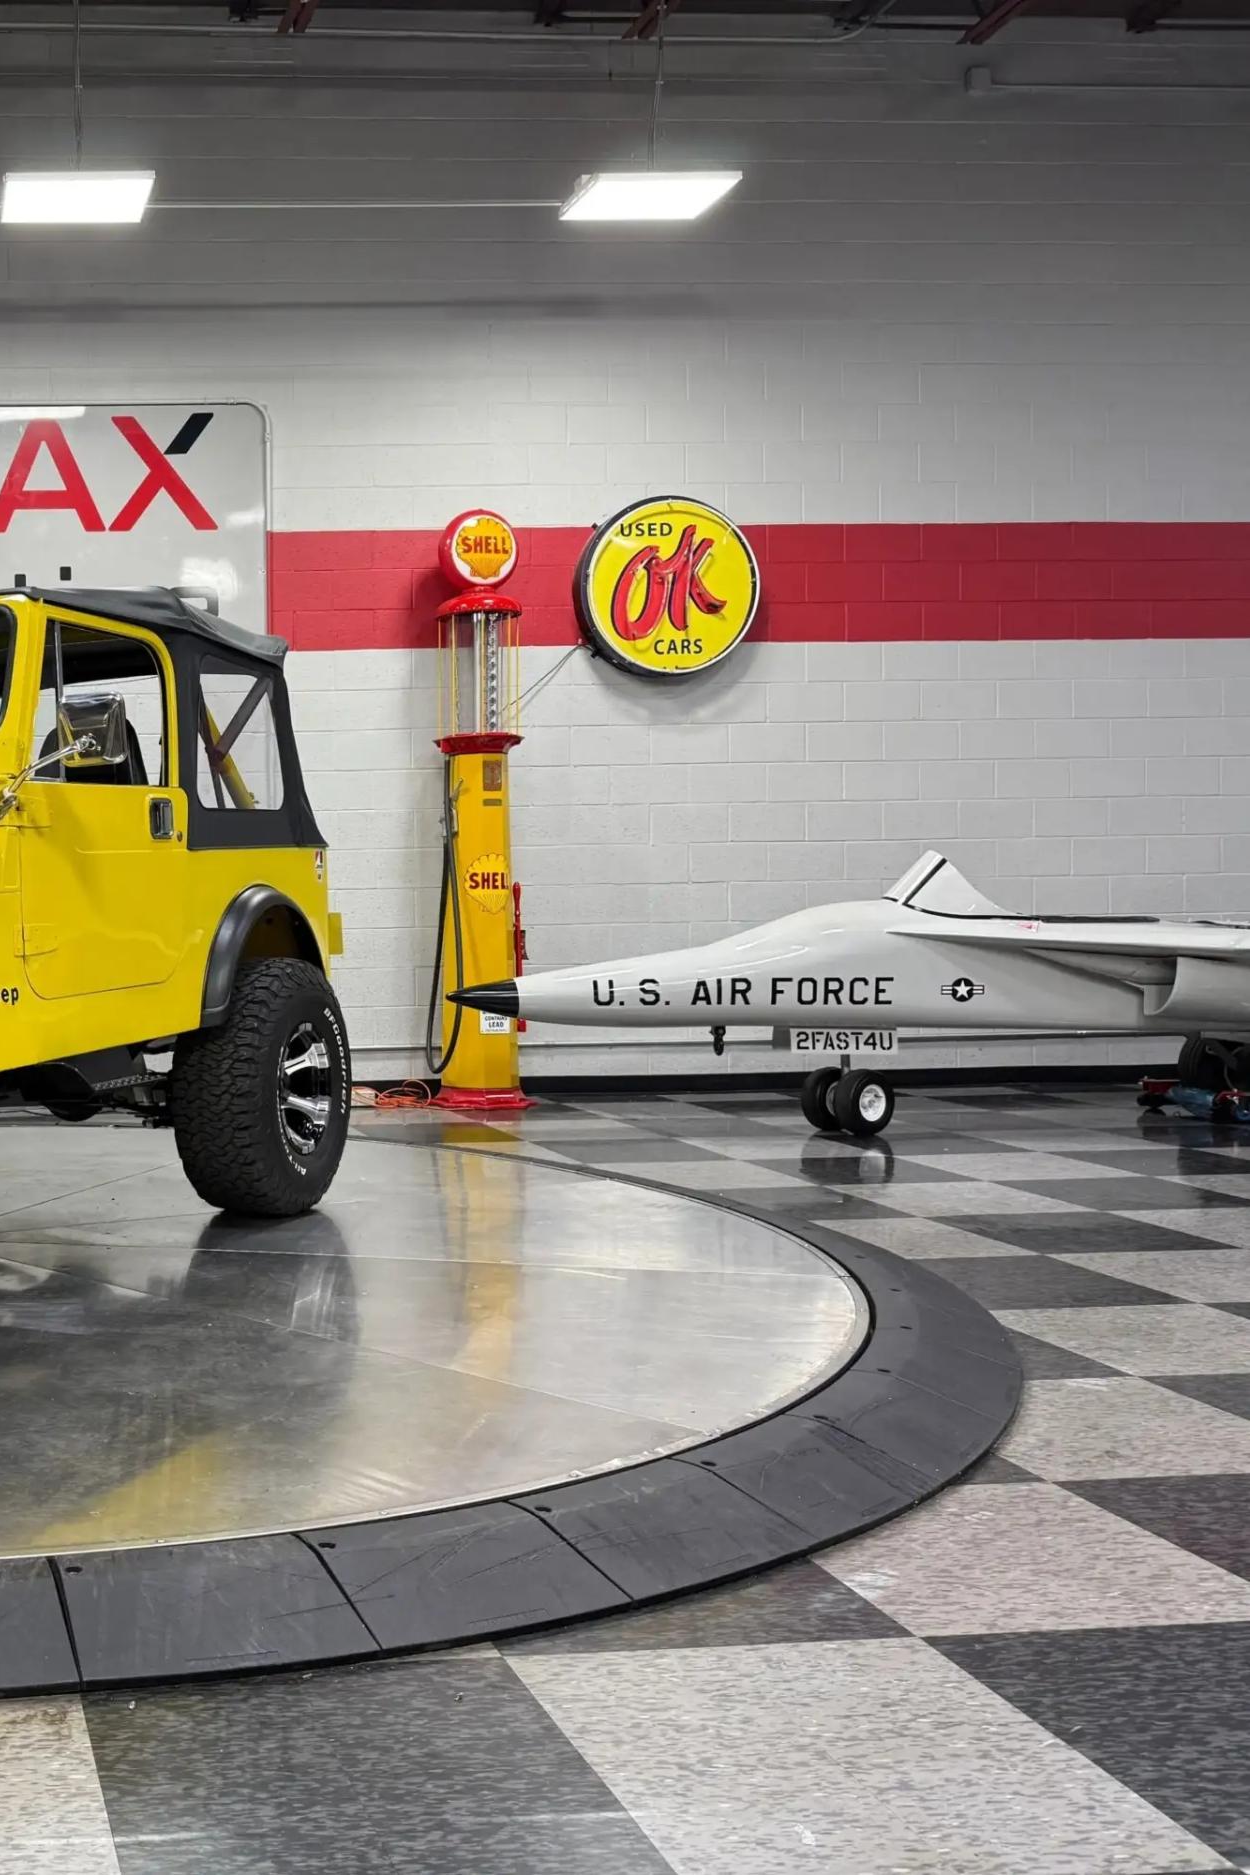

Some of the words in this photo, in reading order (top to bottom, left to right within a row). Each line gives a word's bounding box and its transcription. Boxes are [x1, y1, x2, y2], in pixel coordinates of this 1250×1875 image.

[620, 523, 673, 537] USED
[460, 535, 509, 555] SHELL
[611, 524, 727, 641] OK
[654, 639, 703, 655] CARS
[469, 872, 509, 890] SHEL
[691, 977, 751, 1005] AIR
[770, 977, 894, 1005] FORCE
[795, 1032, 894, 1051] 2FAST4U
